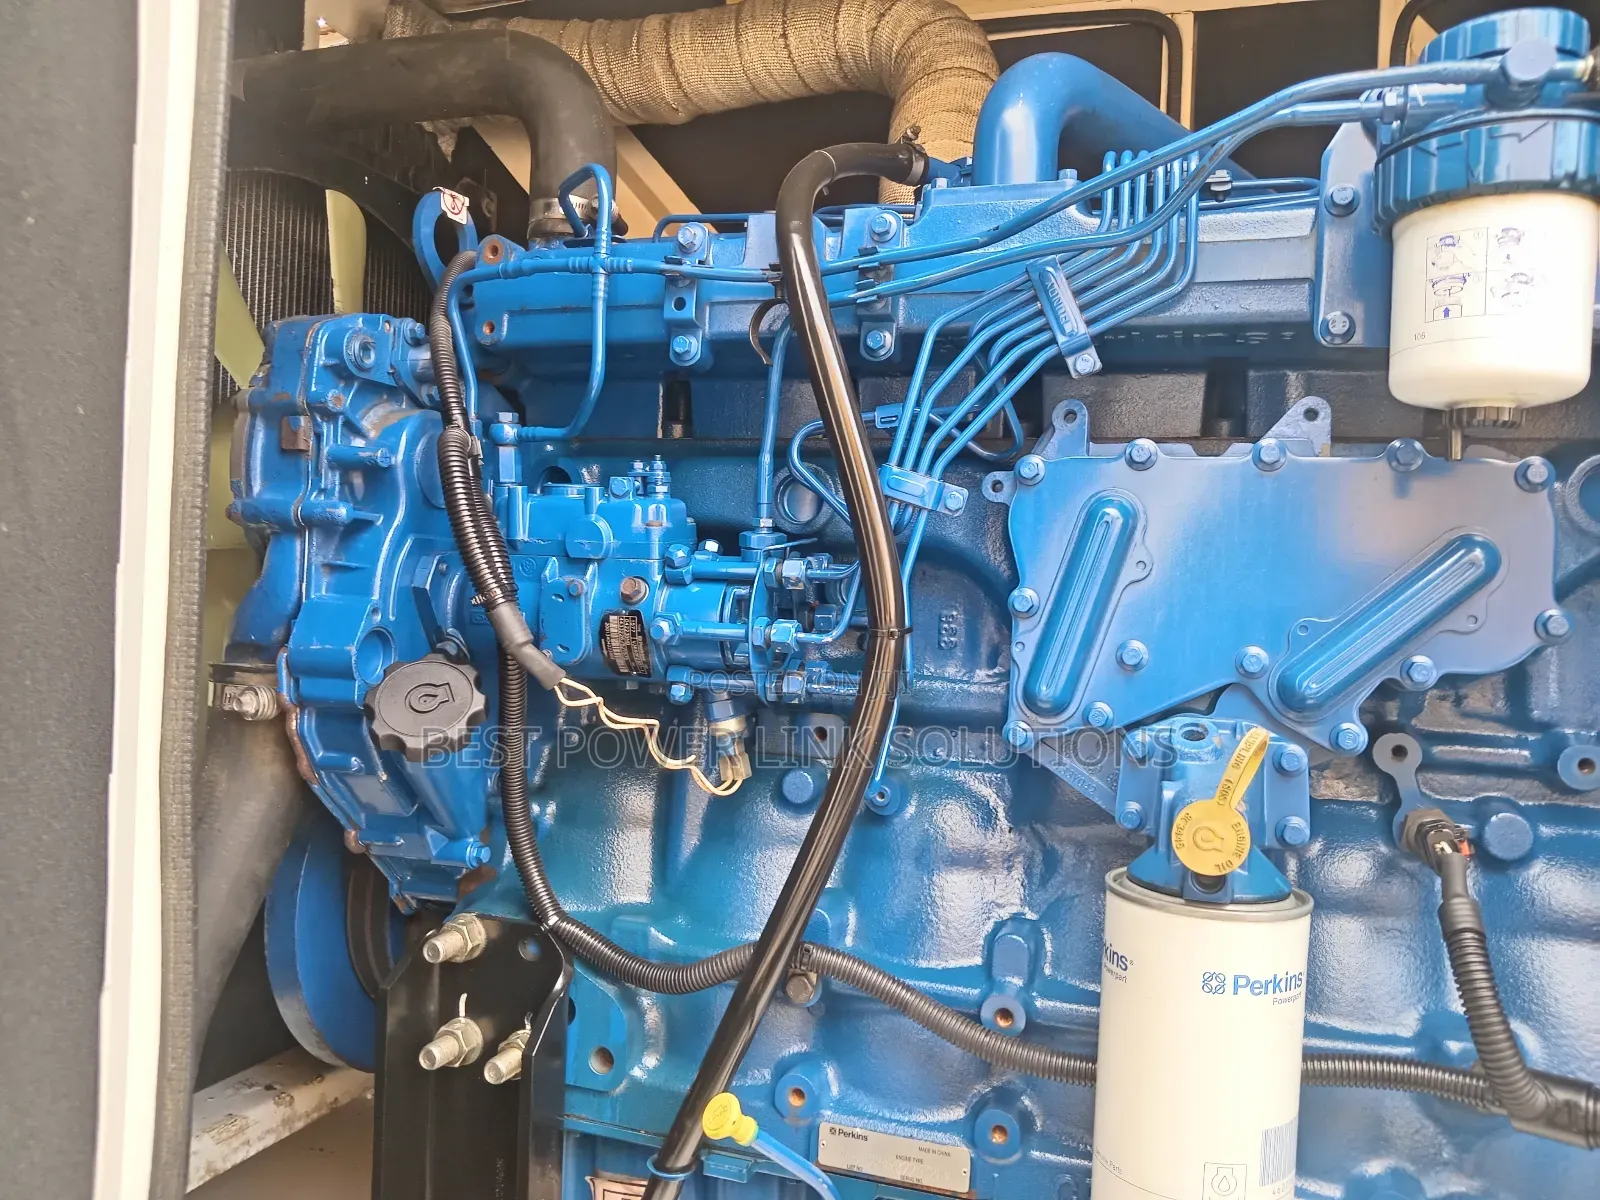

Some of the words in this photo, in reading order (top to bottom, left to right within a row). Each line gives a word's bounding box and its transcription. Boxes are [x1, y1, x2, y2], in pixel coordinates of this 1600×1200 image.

[1231, 821, 1246, 860] ENGINE
[1214, 859, 1235, 873] OIL
[1232, 971, 1304, 996] Perkins
[837, 1128, 869, 1142] Perkins
[918, 1146, 931, 1154] MADE
[936, 1149, 951, 1157] CHINA
[895, 1154, 912, 1162] ENGINE
[912, 1156, 924, 1165] TYPE
